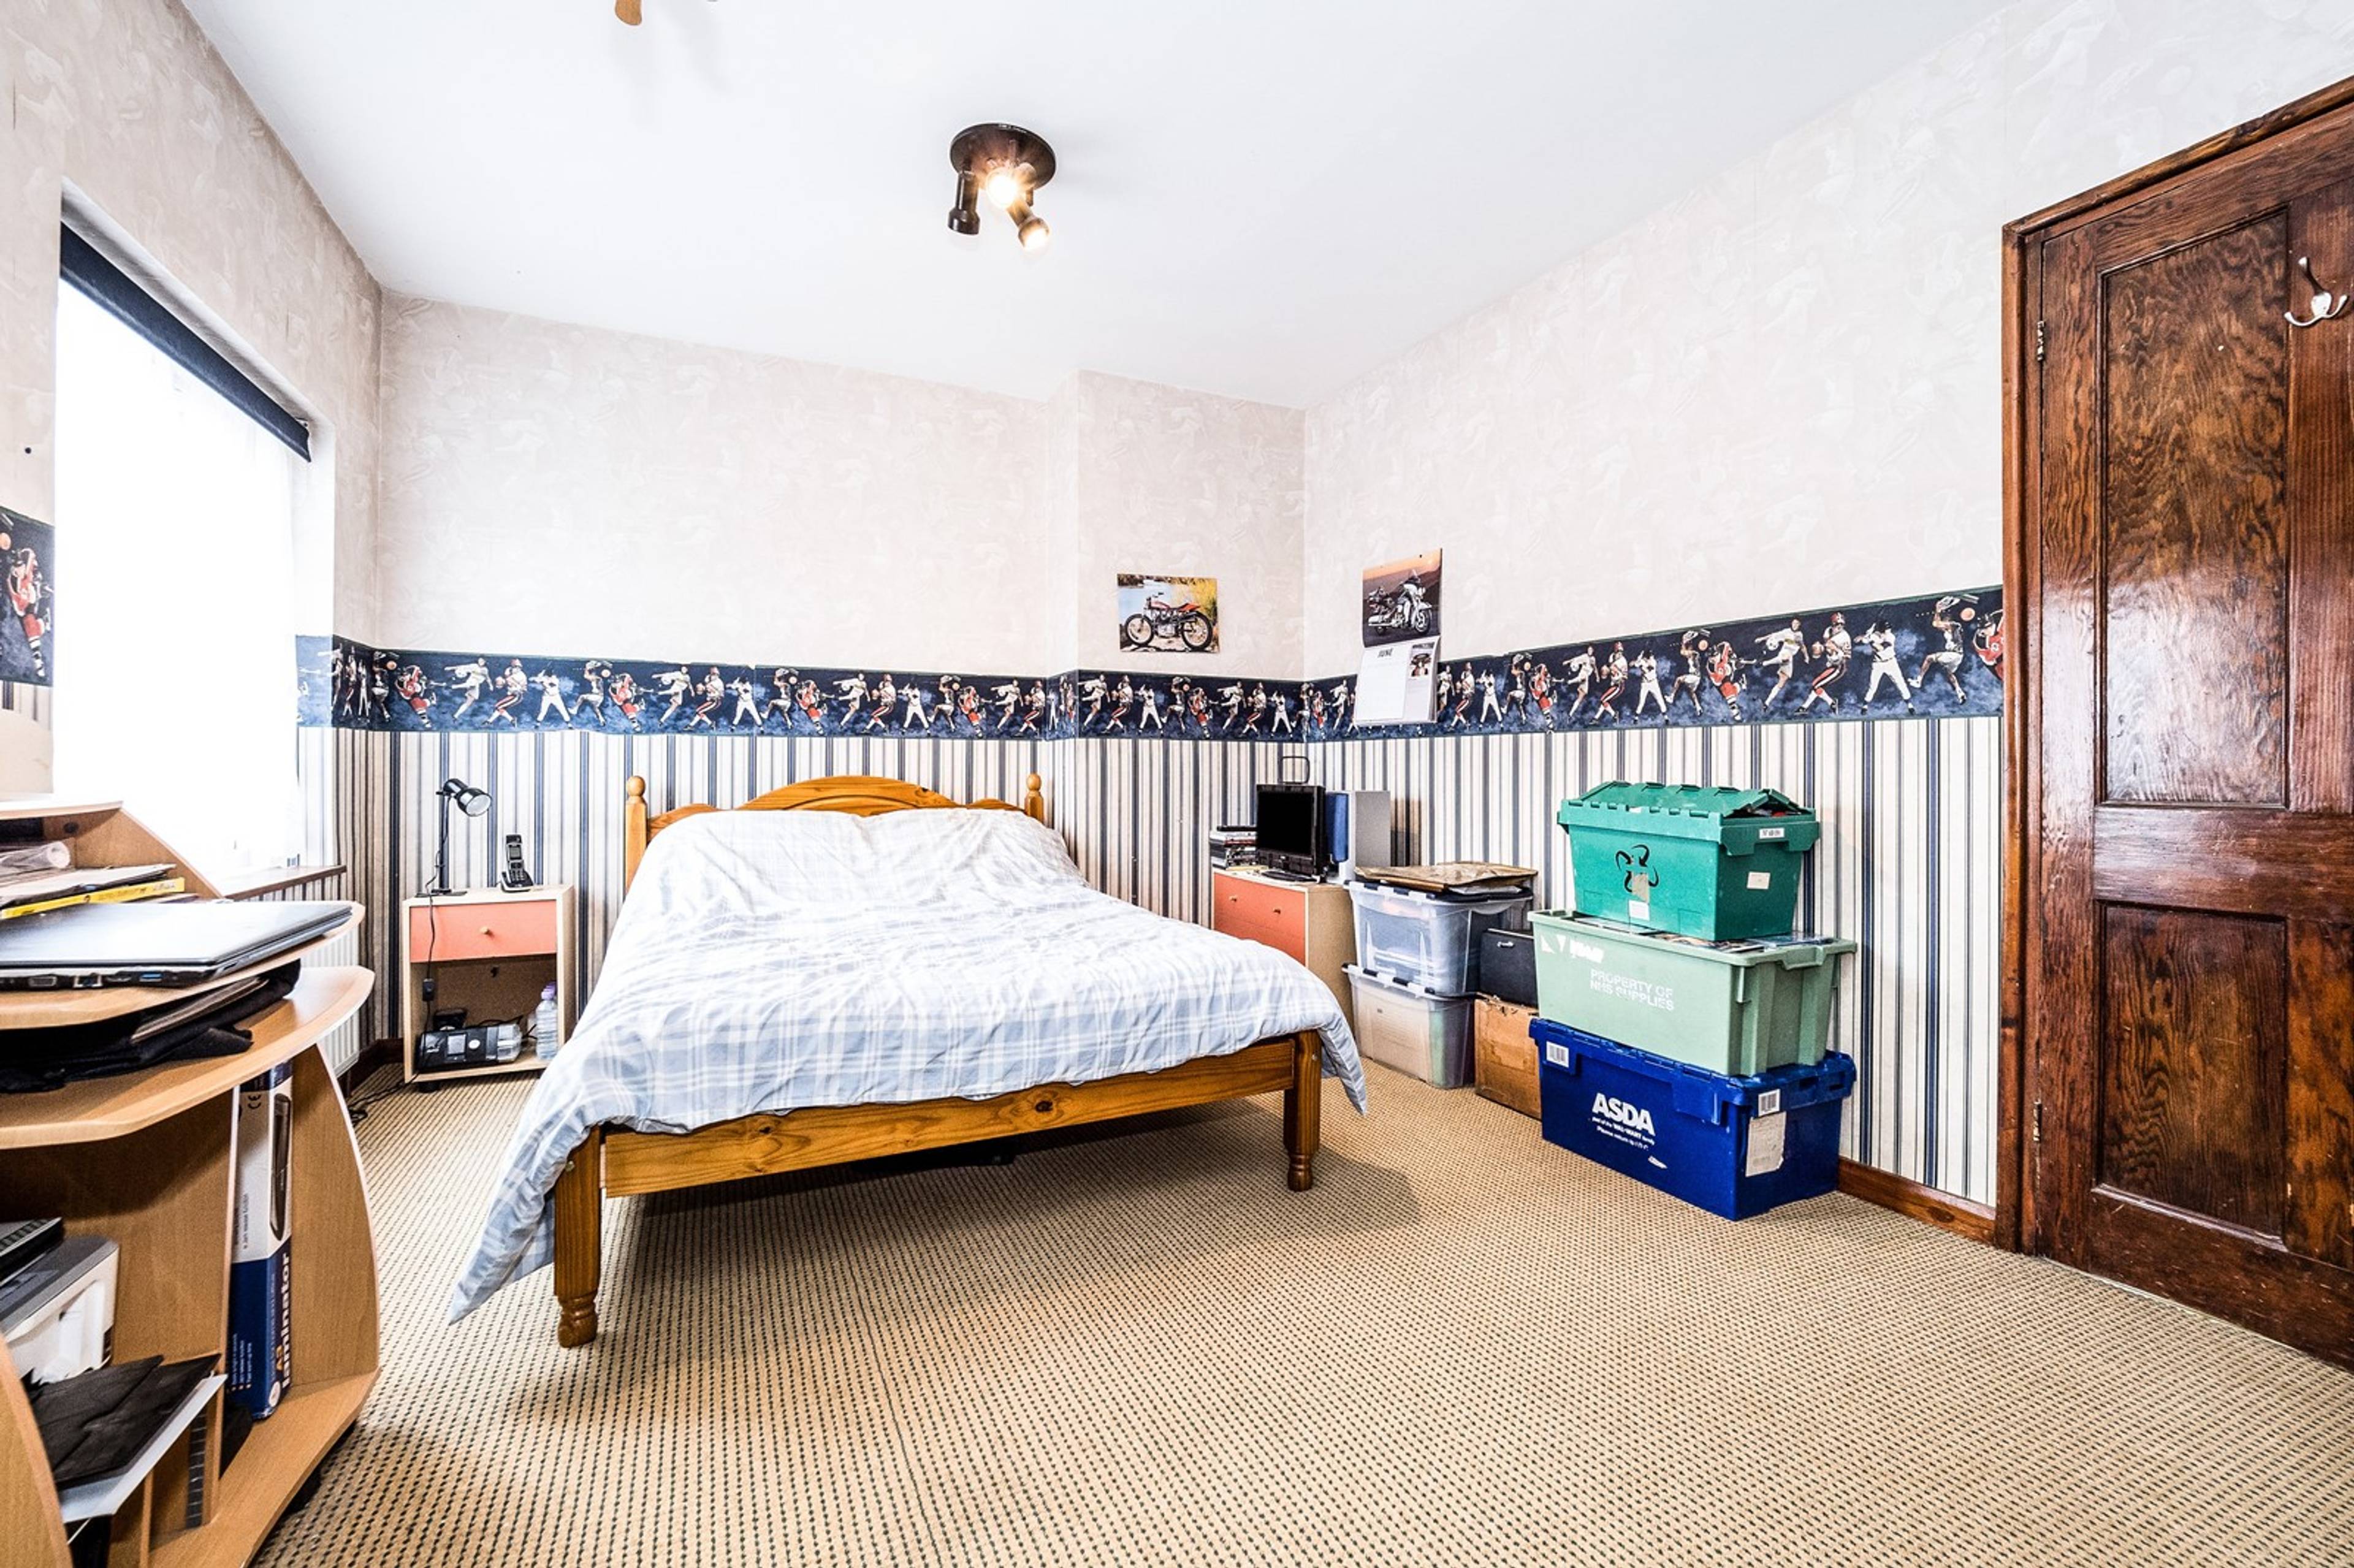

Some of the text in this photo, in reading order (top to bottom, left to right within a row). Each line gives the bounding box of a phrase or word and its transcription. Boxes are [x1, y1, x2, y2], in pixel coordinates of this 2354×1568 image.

[1590, 968, 1652, 993] PROPERTY
[1615, 986, 1675, 1011] SUPPLIES
[1592, 1092, 1656, 1137] ASDA
[281, 1252, 291, 1389] laminator
